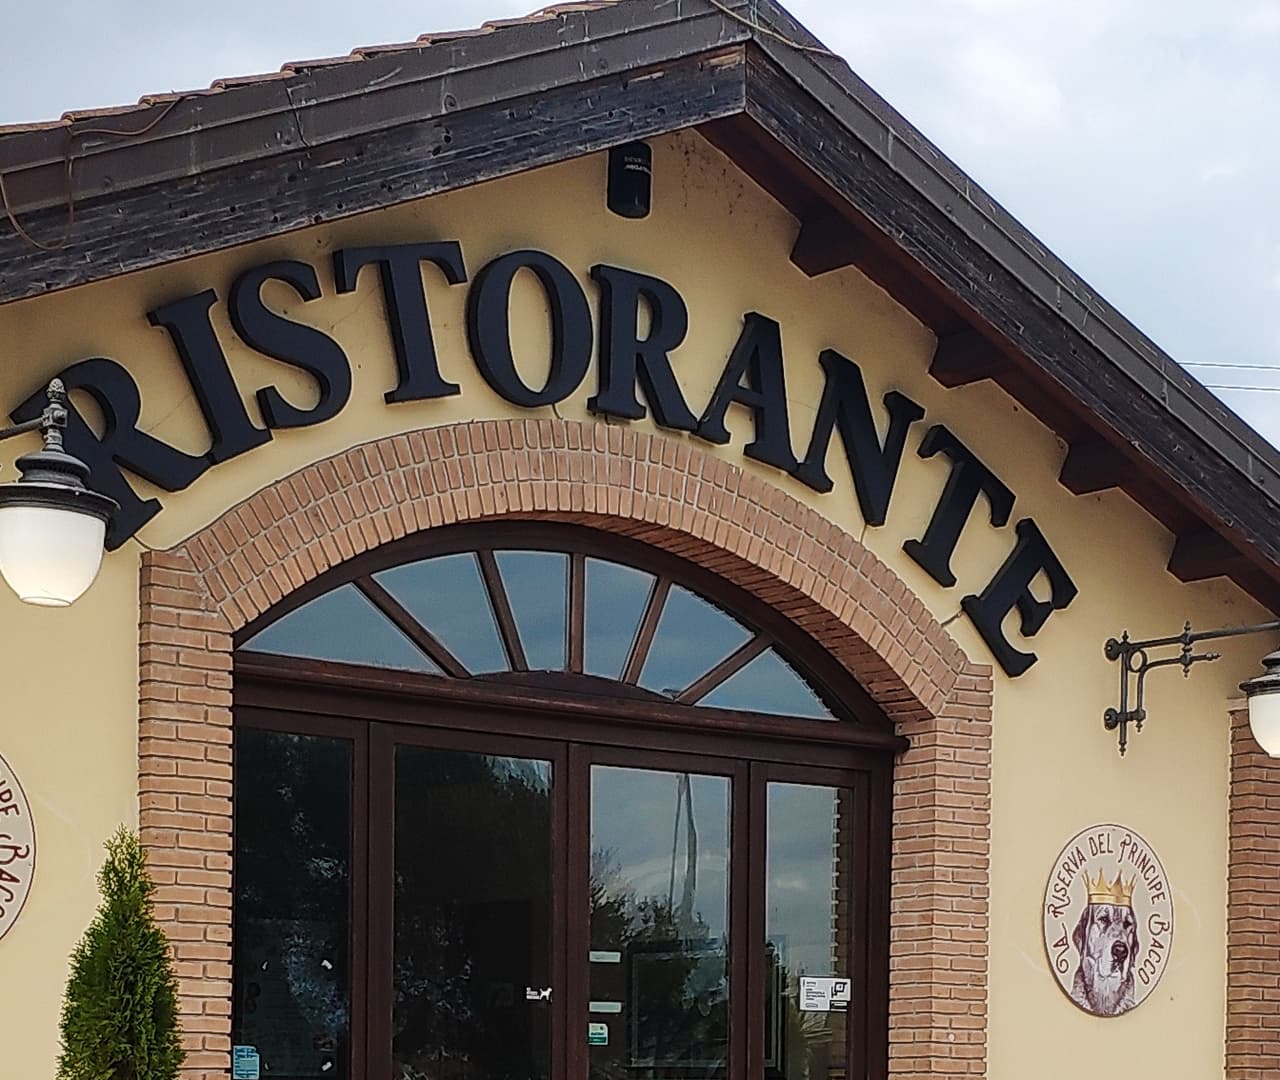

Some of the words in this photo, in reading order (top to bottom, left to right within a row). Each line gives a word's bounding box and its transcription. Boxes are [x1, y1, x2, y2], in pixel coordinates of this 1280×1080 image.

[7, 241, 1080, 678] RISTORANTE
[1088, 832, 1114, 857] DEL
[1117, 833, 1167, 905] PRINCIPE
[1047, 846, 1088, 919] RISERVA
[1138, 913, 1171, 986] BACCO
